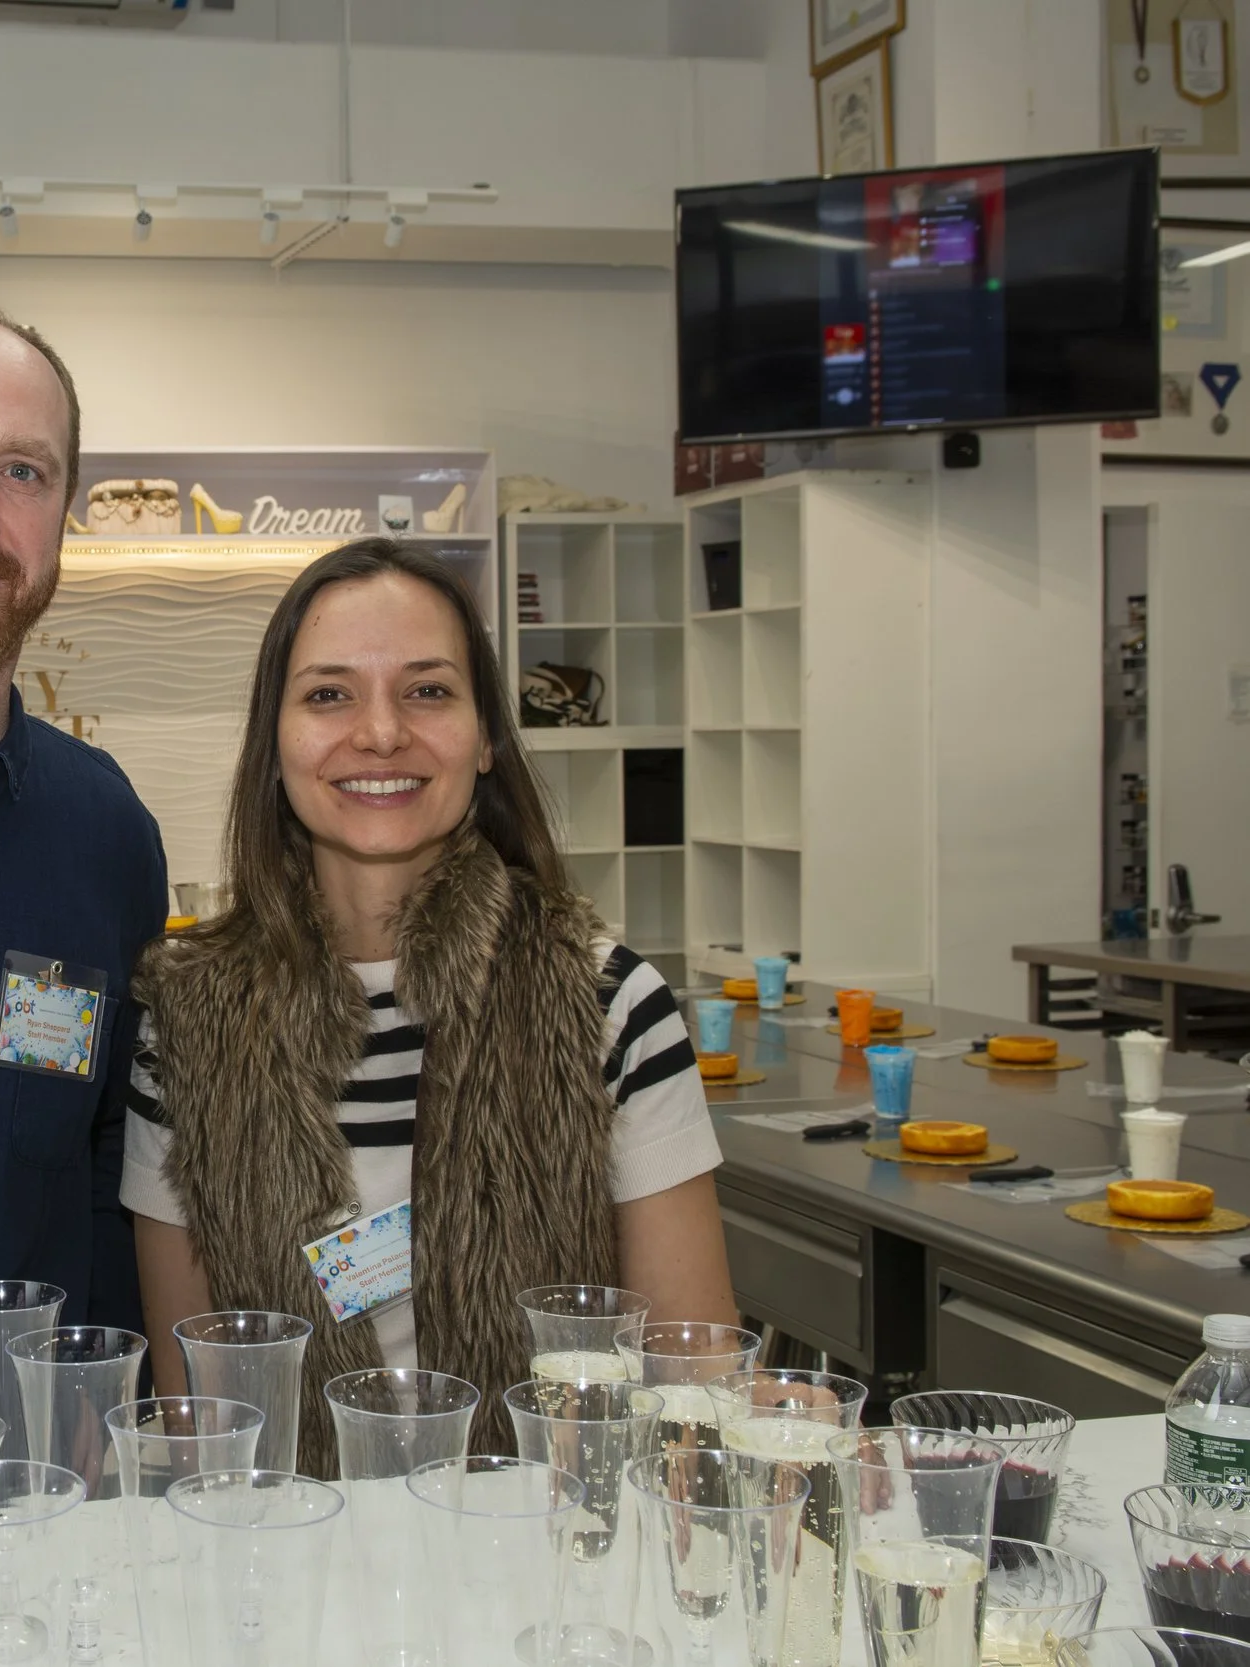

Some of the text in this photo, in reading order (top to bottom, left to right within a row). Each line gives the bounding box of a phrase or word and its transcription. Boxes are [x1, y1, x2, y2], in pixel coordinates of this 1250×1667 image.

[249, 495, 365, 534] Dream
[27, 1018, 42, 1029] Ryan
[28, 1030, 67, 1044] Staff Member
[346, 1261, 383, 1282] Valentina
[359, 1261, 411, 1288] Staff Member
